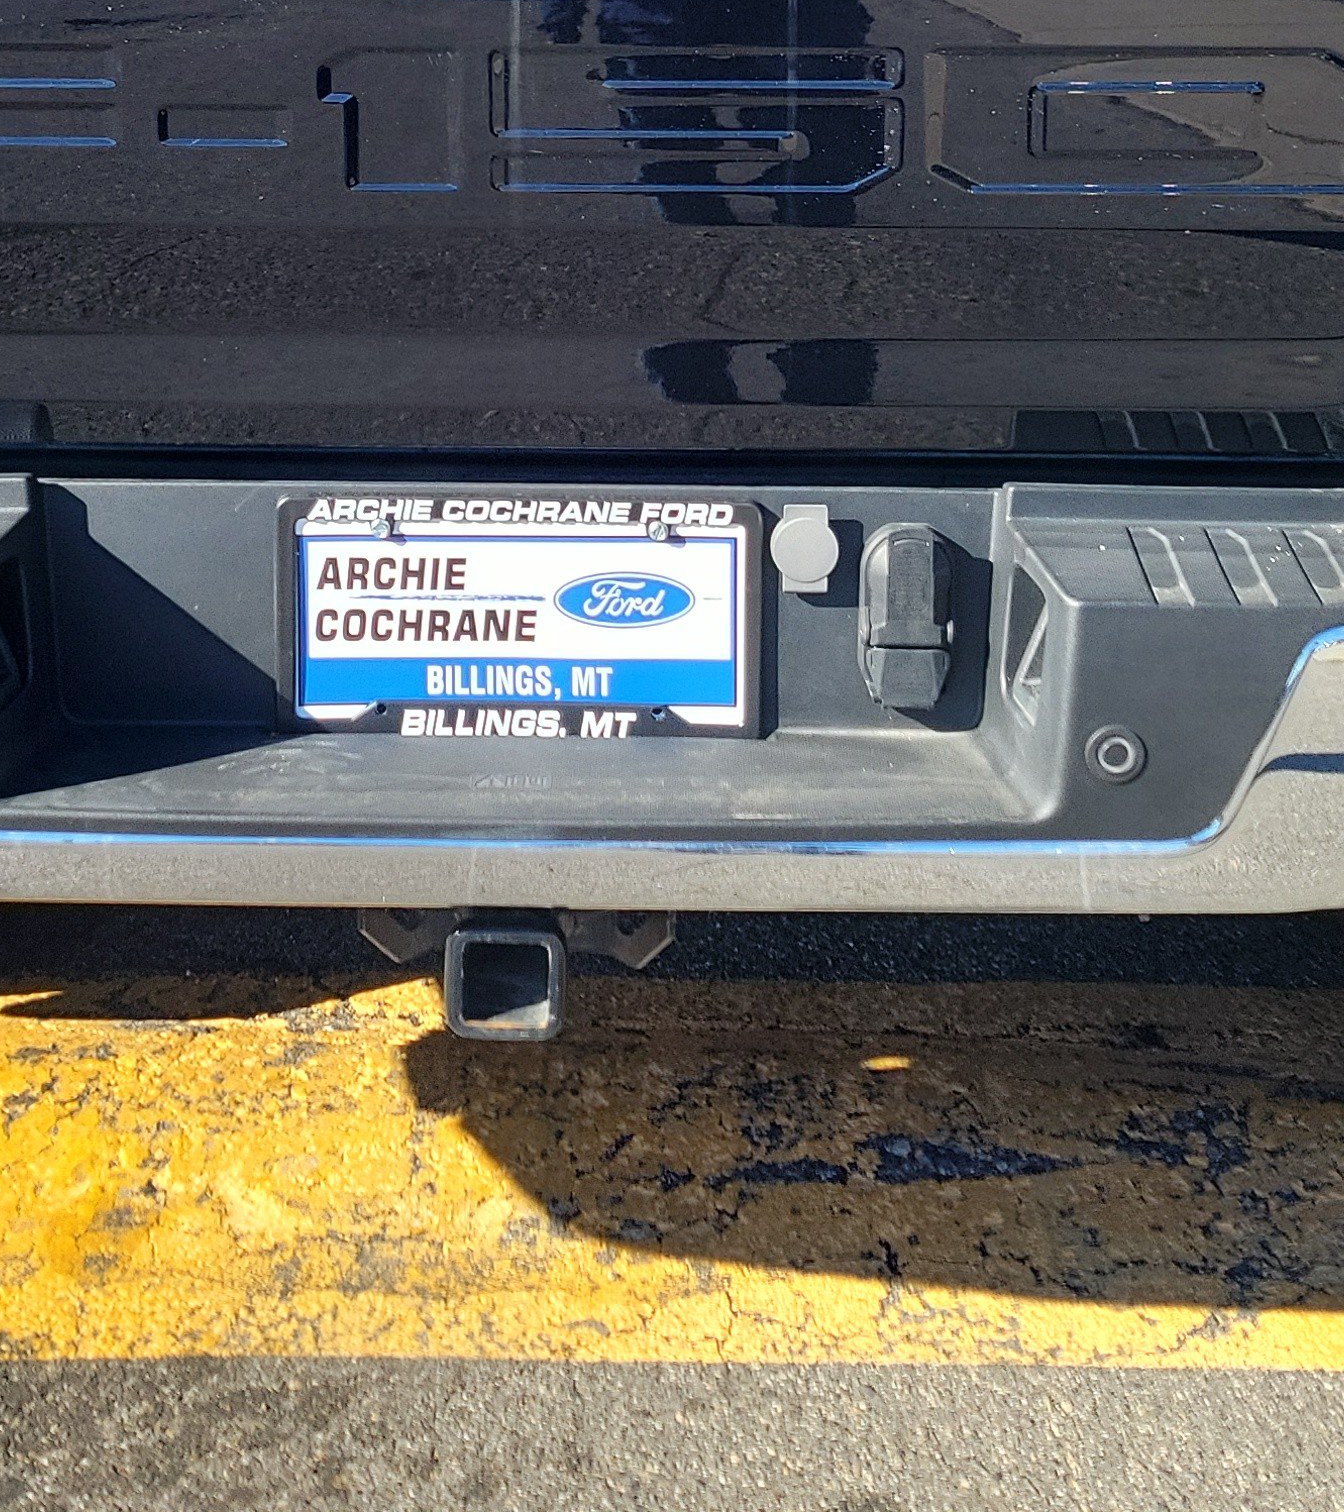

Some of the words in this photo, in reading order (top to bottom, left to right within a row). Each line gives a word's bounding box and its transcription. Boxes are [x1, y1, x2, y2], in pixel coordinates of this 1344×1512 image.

[307, 498, 434, 522] ARCHIE
[442, 499, 630, 524] COCHRANE
[639, 502, 734, 527] FORD
[316, 557, 467, 591] ARCHIE
[583, 579, 666, 619] Ford
[315, 608, 538, 643] COCHRANE
[427, 664, 562, 701] BILLINGS,
[570, 666, 614, 698] MT
[579, 710, 638, 739] MT
